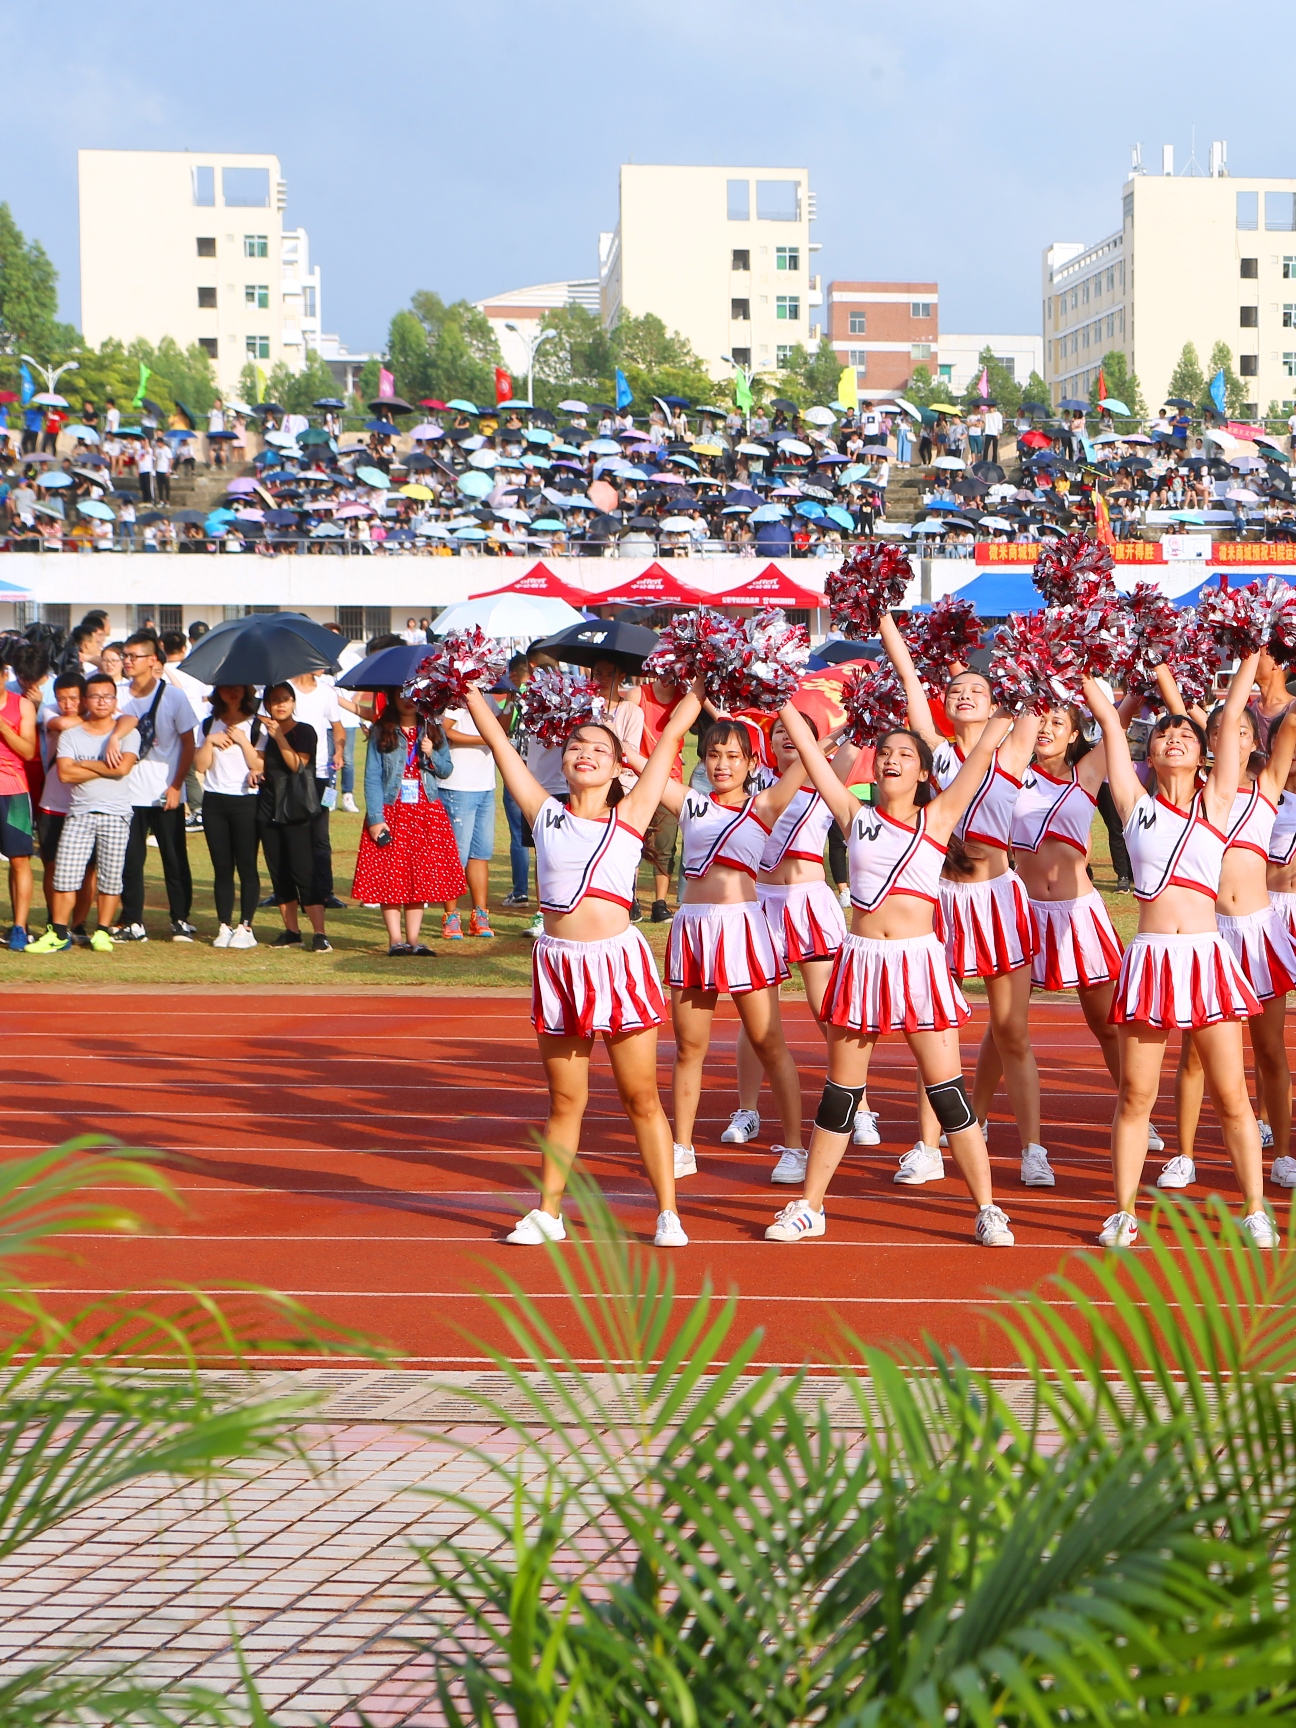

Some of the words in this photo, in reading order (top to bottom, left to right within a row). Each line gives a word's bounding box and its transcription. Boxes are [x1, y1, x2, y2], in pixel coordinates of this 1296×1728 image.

[687, 798, 709, 820] W
[1138, 807, 1157, 830] W
[858, 819, 882, 842] W
